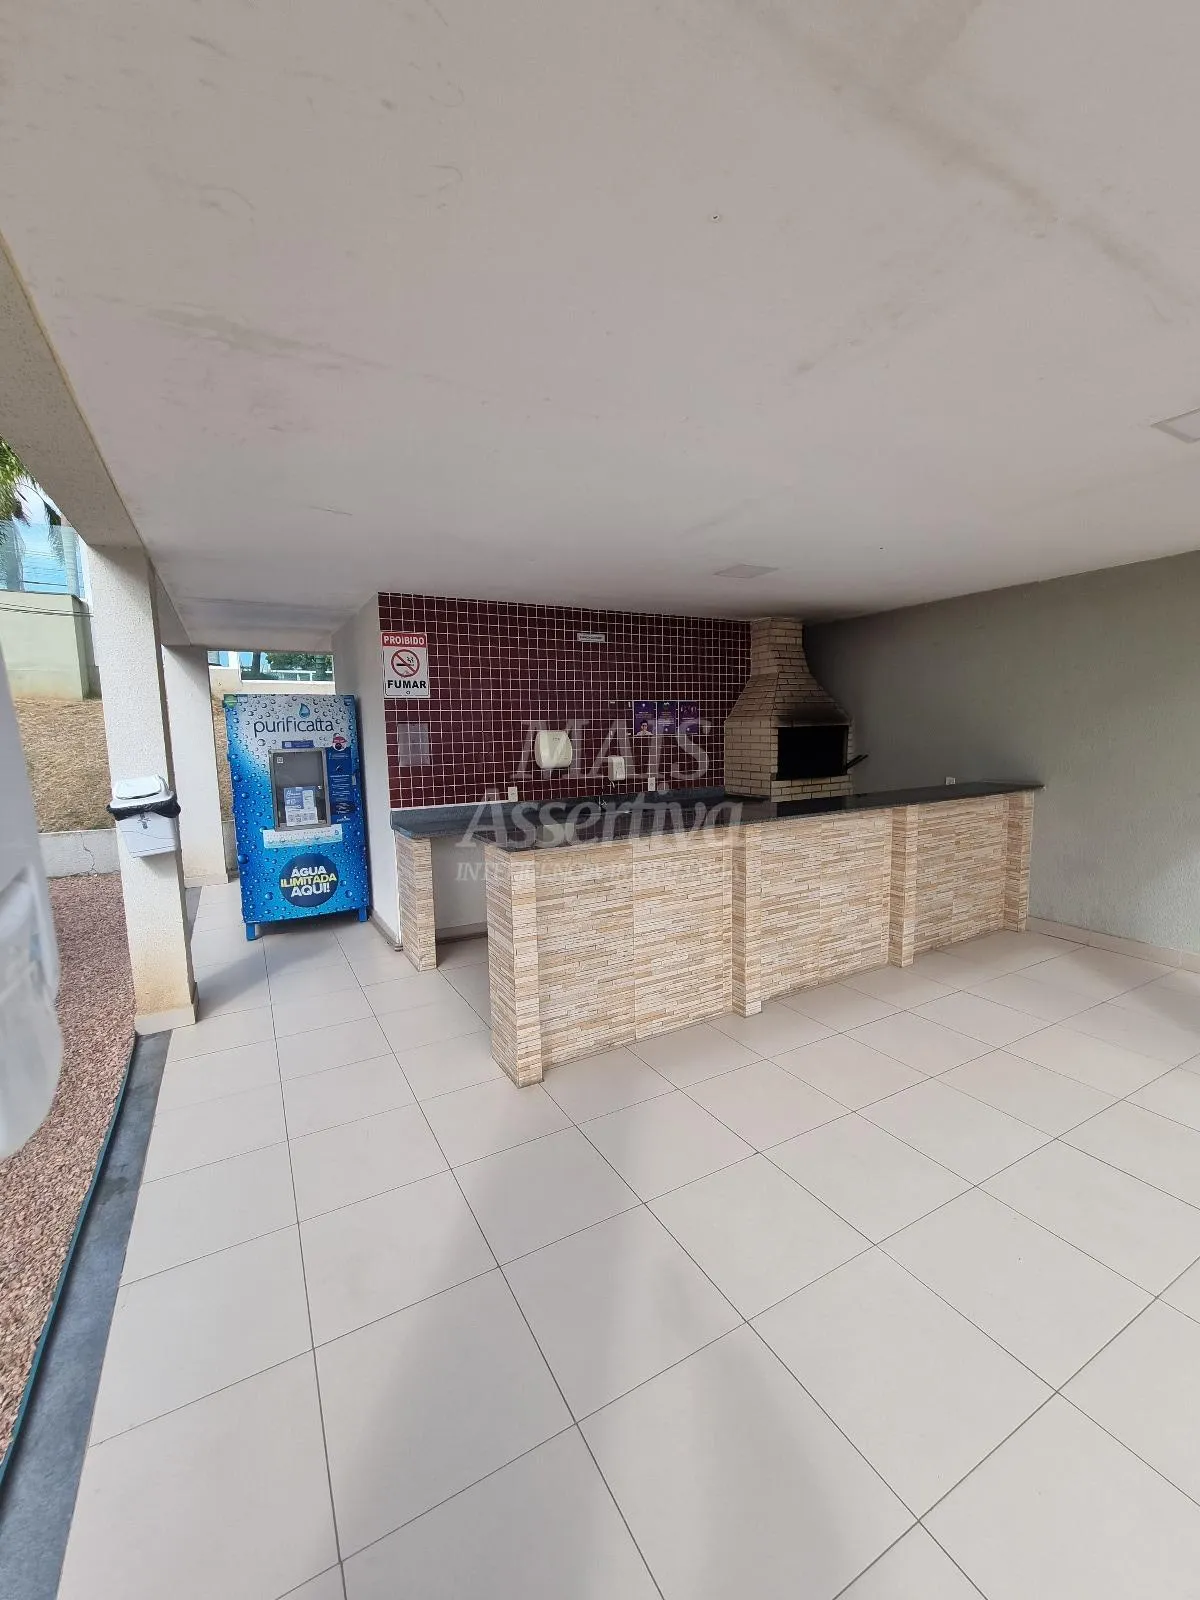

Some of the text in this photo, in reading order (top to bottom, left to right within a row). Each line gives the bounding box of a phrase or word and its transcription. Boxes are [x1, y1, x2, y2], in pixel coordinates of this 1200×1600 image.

[383, 635, 425, 646] PROIBIDO
[387, 680, 427, 689] FUMAR
[253, 716, 335, 738] purificatta
[290, 865, 327, 878] ÁGUA
[280, 873, 337, 888] ILIMITADA
[290, 882, 331, 898] AQUI!
